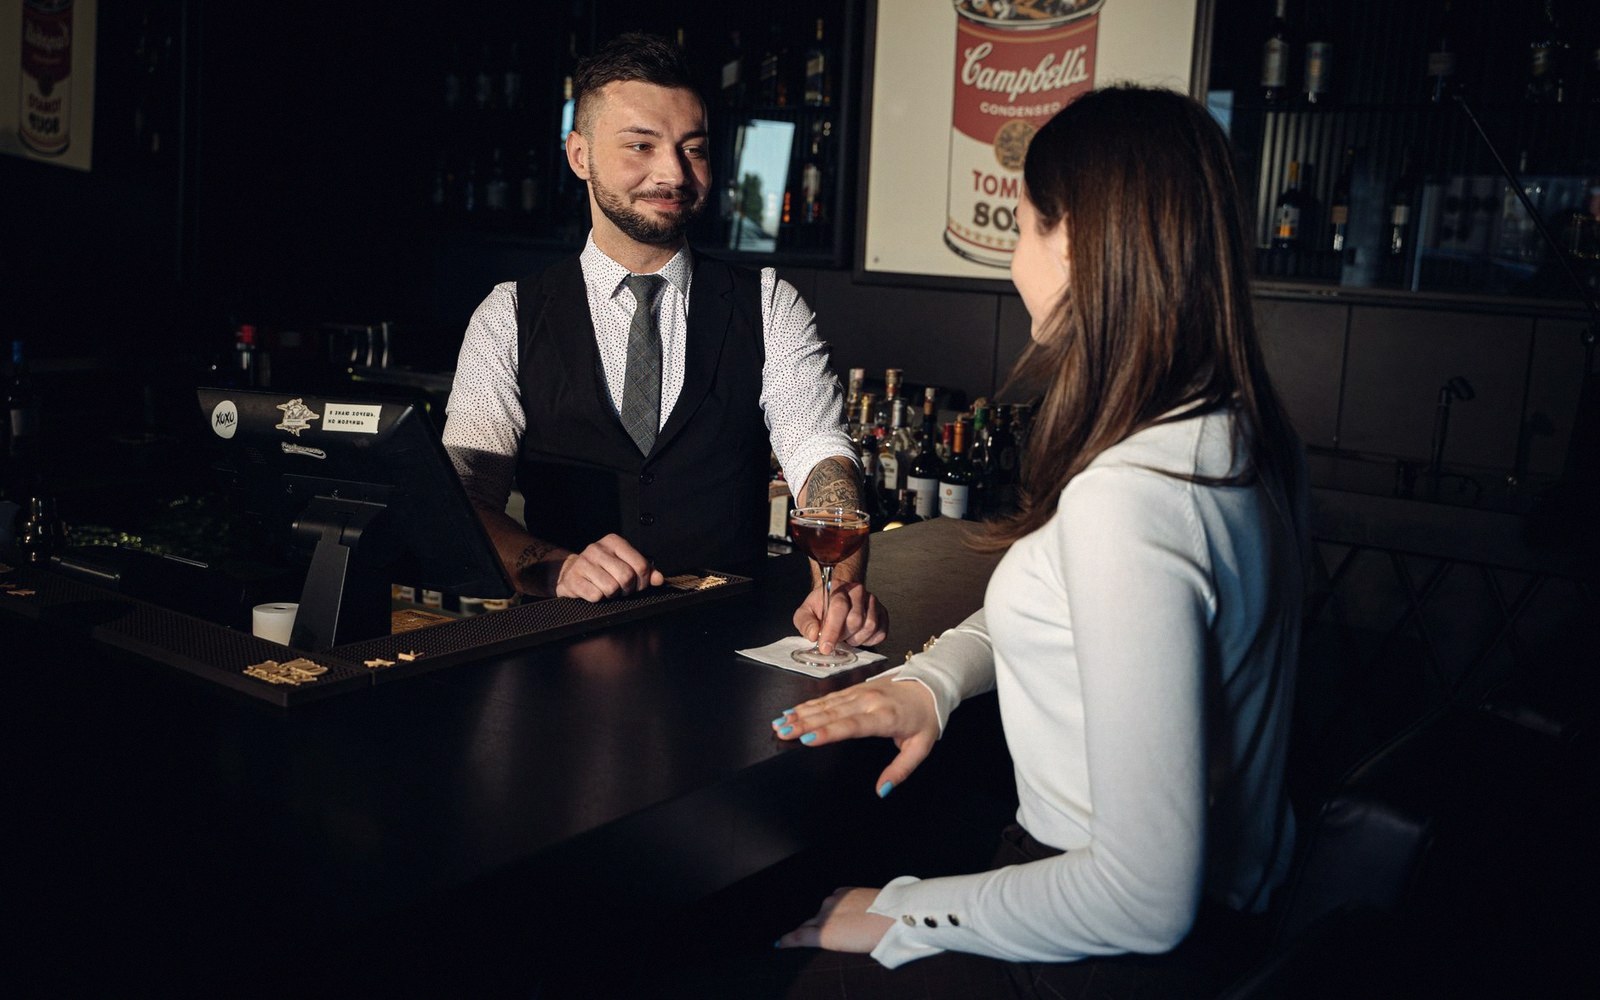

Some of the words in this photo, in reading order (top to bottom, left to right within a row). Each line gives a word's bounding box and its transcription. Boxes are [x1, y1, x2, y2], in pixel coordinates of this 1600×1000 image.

[961, 41, 1089, 103] Campbell's
[979, 101, 1062, 118] CONDENSED
[972, 168, 1025, 199] TOM
[972, 201, 1015, 232] SO
